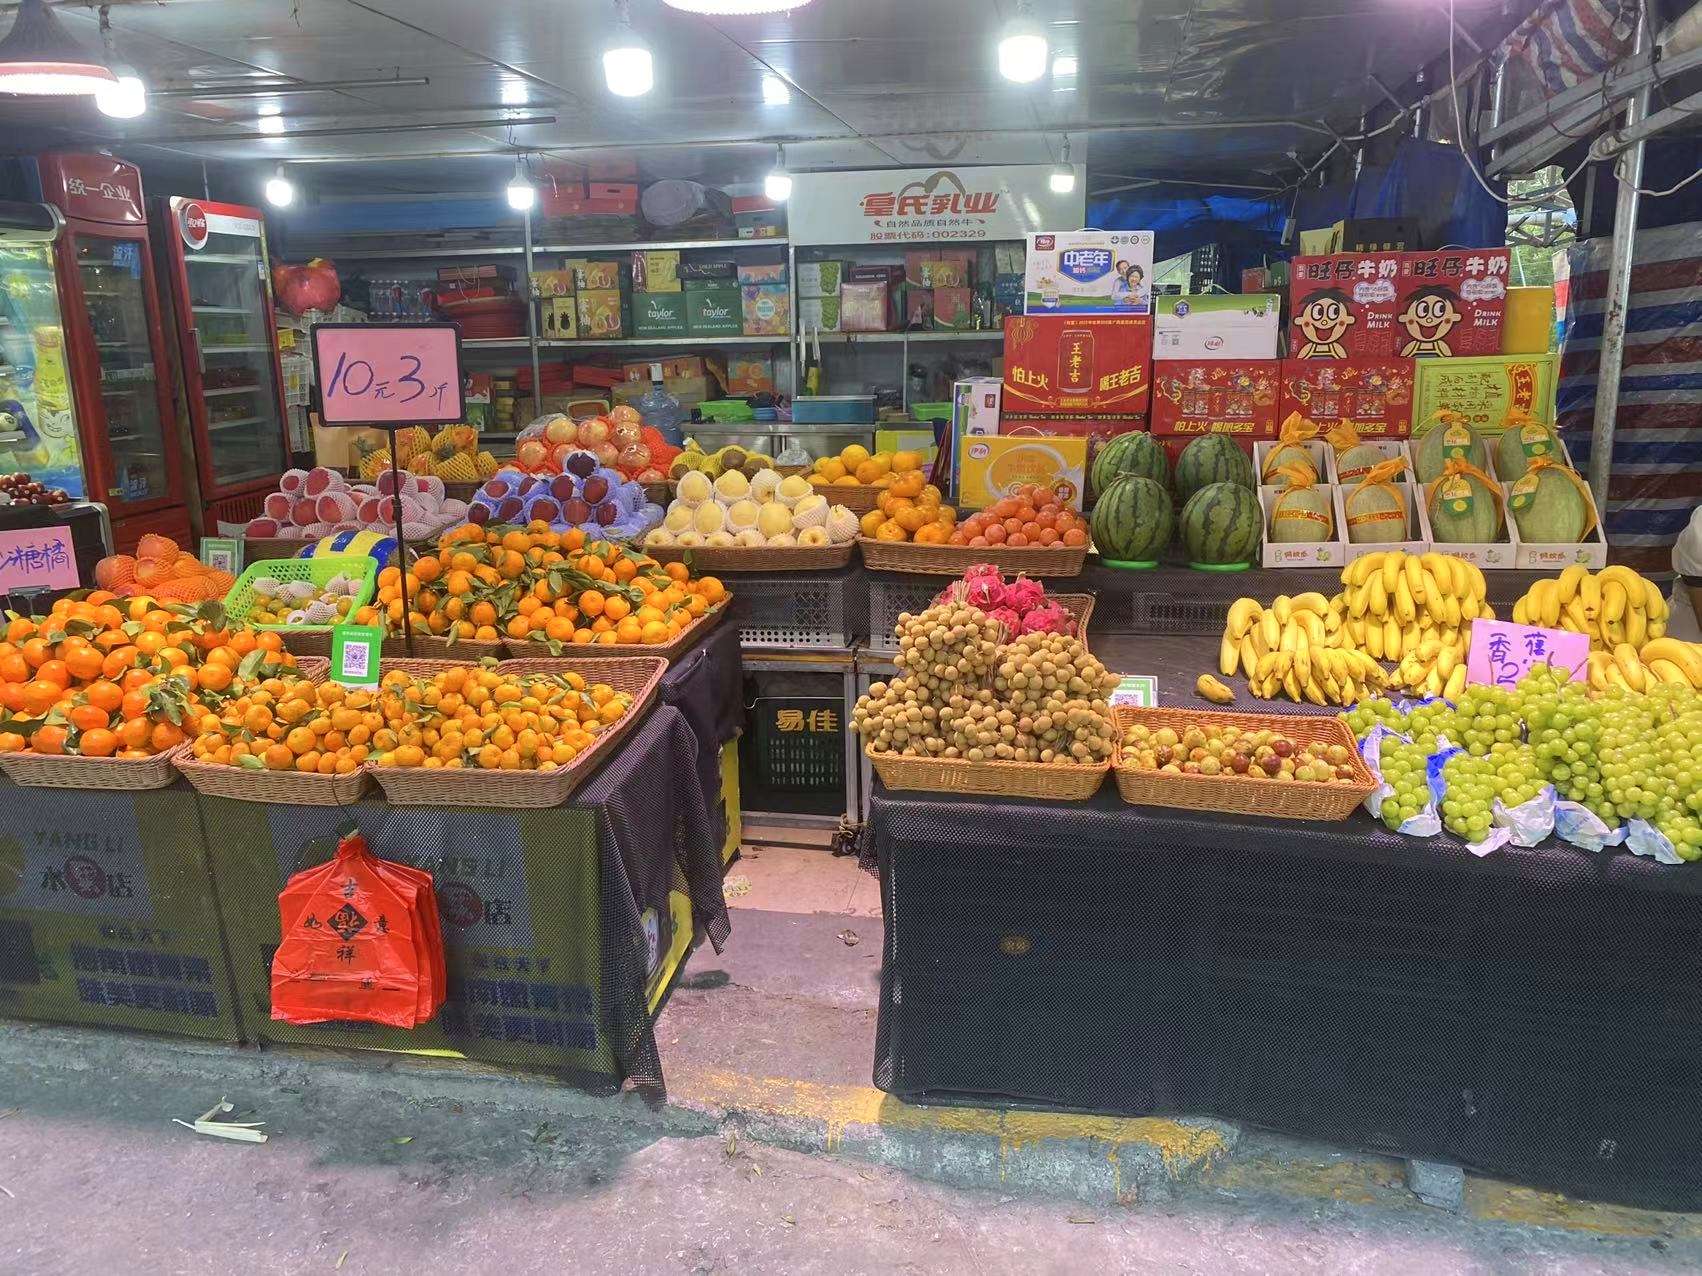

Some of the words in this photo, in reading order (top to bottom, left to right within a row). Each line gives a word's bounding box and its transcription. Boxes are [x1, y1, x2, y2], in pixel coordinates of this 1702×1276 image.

[69, 178, 132, 201] 统一企业
[863, 191, 1000, 217] 皇氏乳业
[886, 219, 974, 228] 自然品质自然牛
[1064, 250, 1110, 267] 中老年
[648, 308, 675, 320] taylor
[702, 306, 729, 318] taylor
[1367, 312, 1393, 320] DRINK
[1474, 309, 1502, 318] DRINK
[1366, 321, 1390, 329] MILK
[1473, 318, 1498, 327] MILK
[1070, 341, 1082, 384] 王老吉
[1012, 366, 1049, 391] 怕上火
[776, 709, 838, 731] 易佳
[336, 944, 356, 965] 祥
